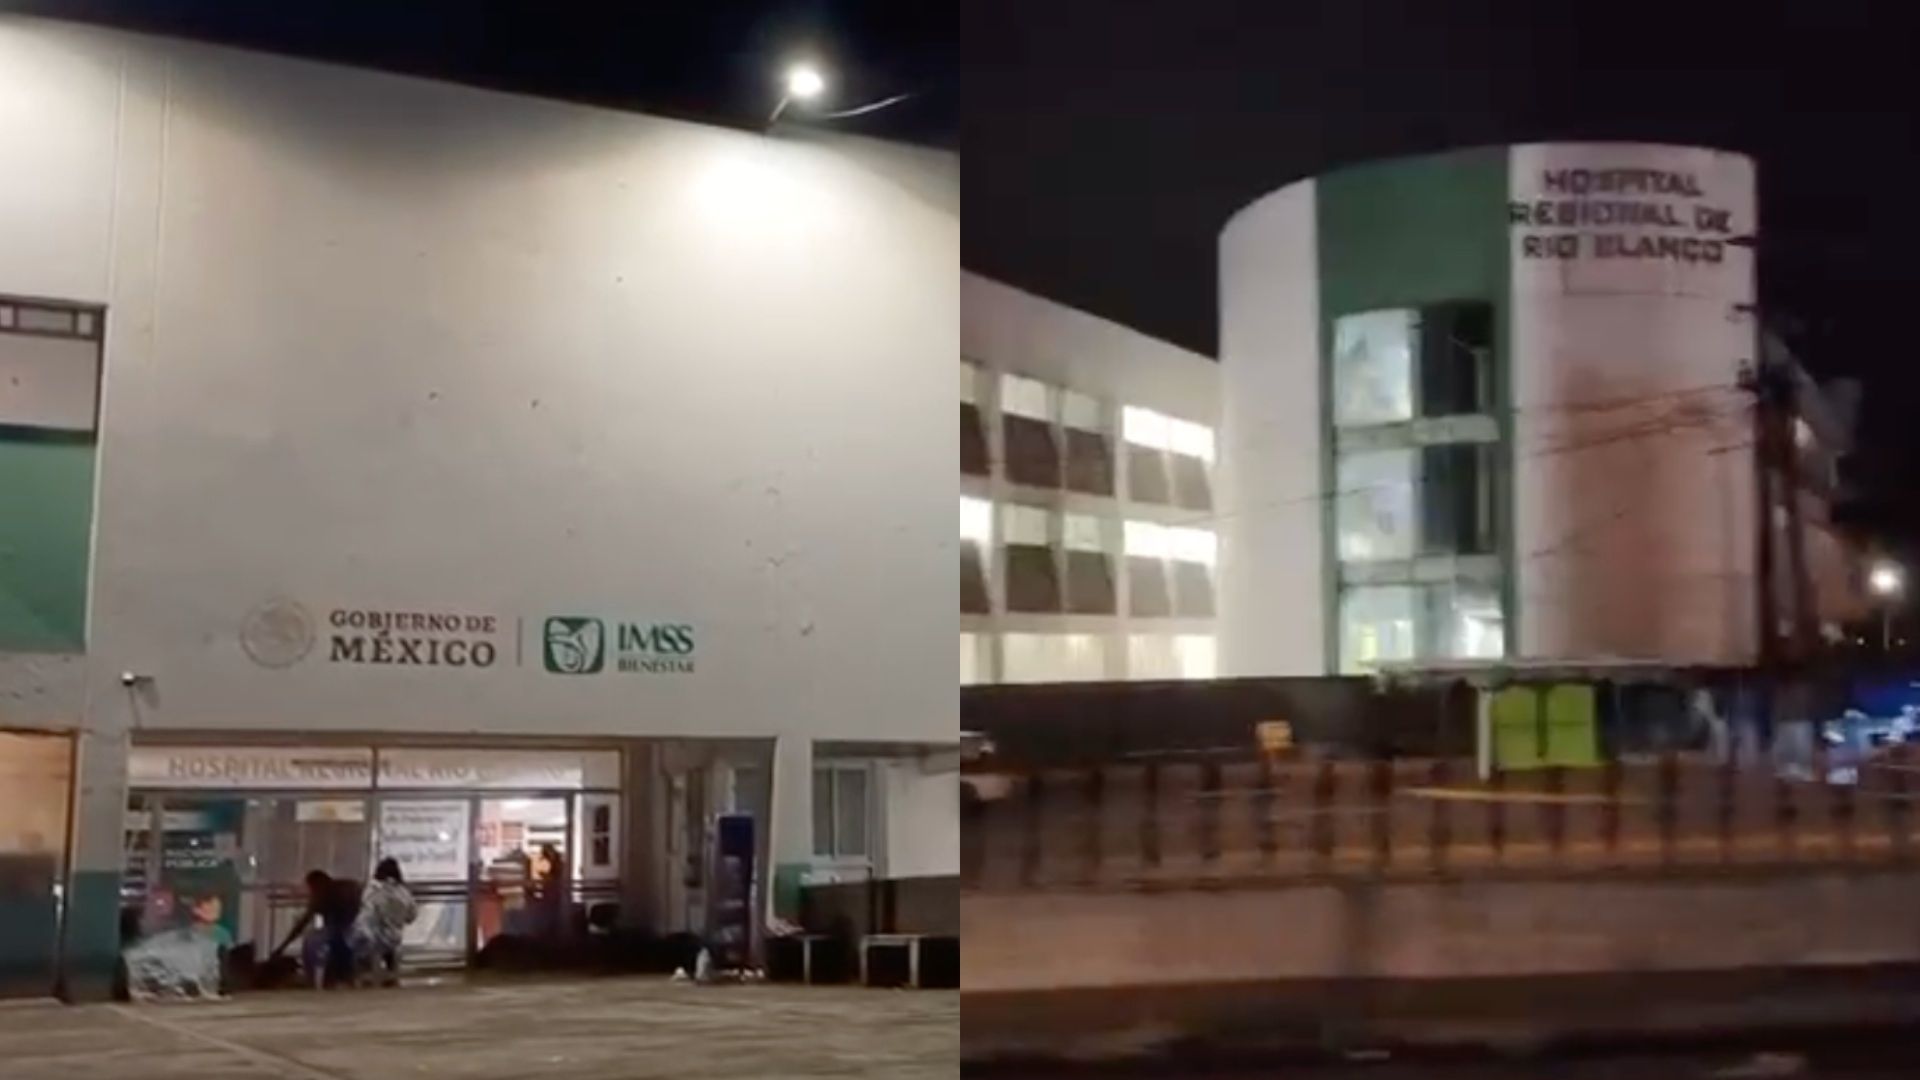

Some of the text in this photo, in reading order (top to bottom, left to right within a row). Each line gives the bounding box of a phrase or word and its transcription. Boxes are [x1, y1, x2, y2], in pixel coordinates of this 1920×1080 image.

[1543, 169, 1704, 197] HOSPITAL
[1508, 202, 1733, 234] REGIONAL DE
[1523, 234, 1723, 263] RIO BLANCO
[329, 609, 496, 633] GOBIERNO DE
[329, 630, 496, 667] MÉXICO
[618, 623, 695, 654] IMSS
[618, 658, 695, 673] BIENESTAR
[168, 756, 294, 779] HOSPITAL
